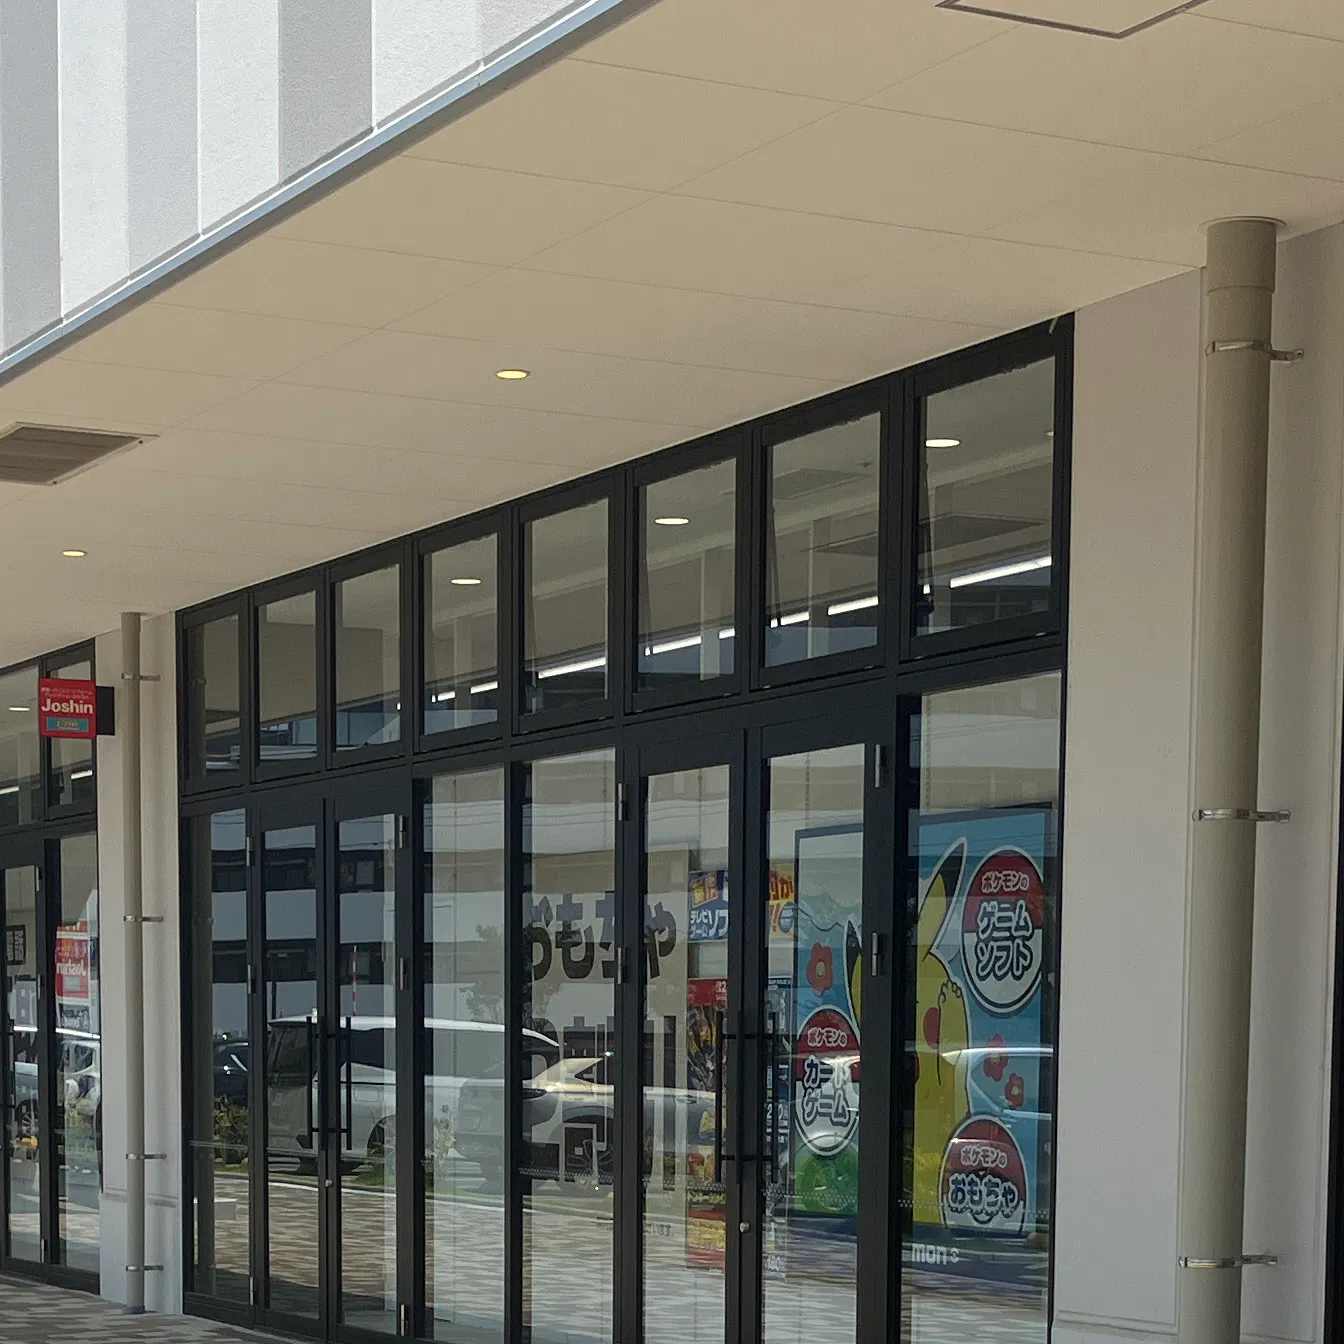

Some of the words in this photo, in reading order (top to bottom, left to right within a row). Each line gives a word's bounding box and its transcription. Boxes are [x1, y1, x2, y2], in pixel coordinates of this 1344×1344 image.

[41, 698, 94, 714] Joshin
[981, 871, 1028, 893] ポケモンの
[976, 899, 1033, 938] ゲーム
[976, 936, 1033, 982] ソフト
[807, 1026, 847, 1047] ポケモンの
[803, 1088, 851, 1126] ゲーム
[960, 1144, 1008, 1168] ポケモンの
[947, 1172, 1020, 1214] おもちゃ
